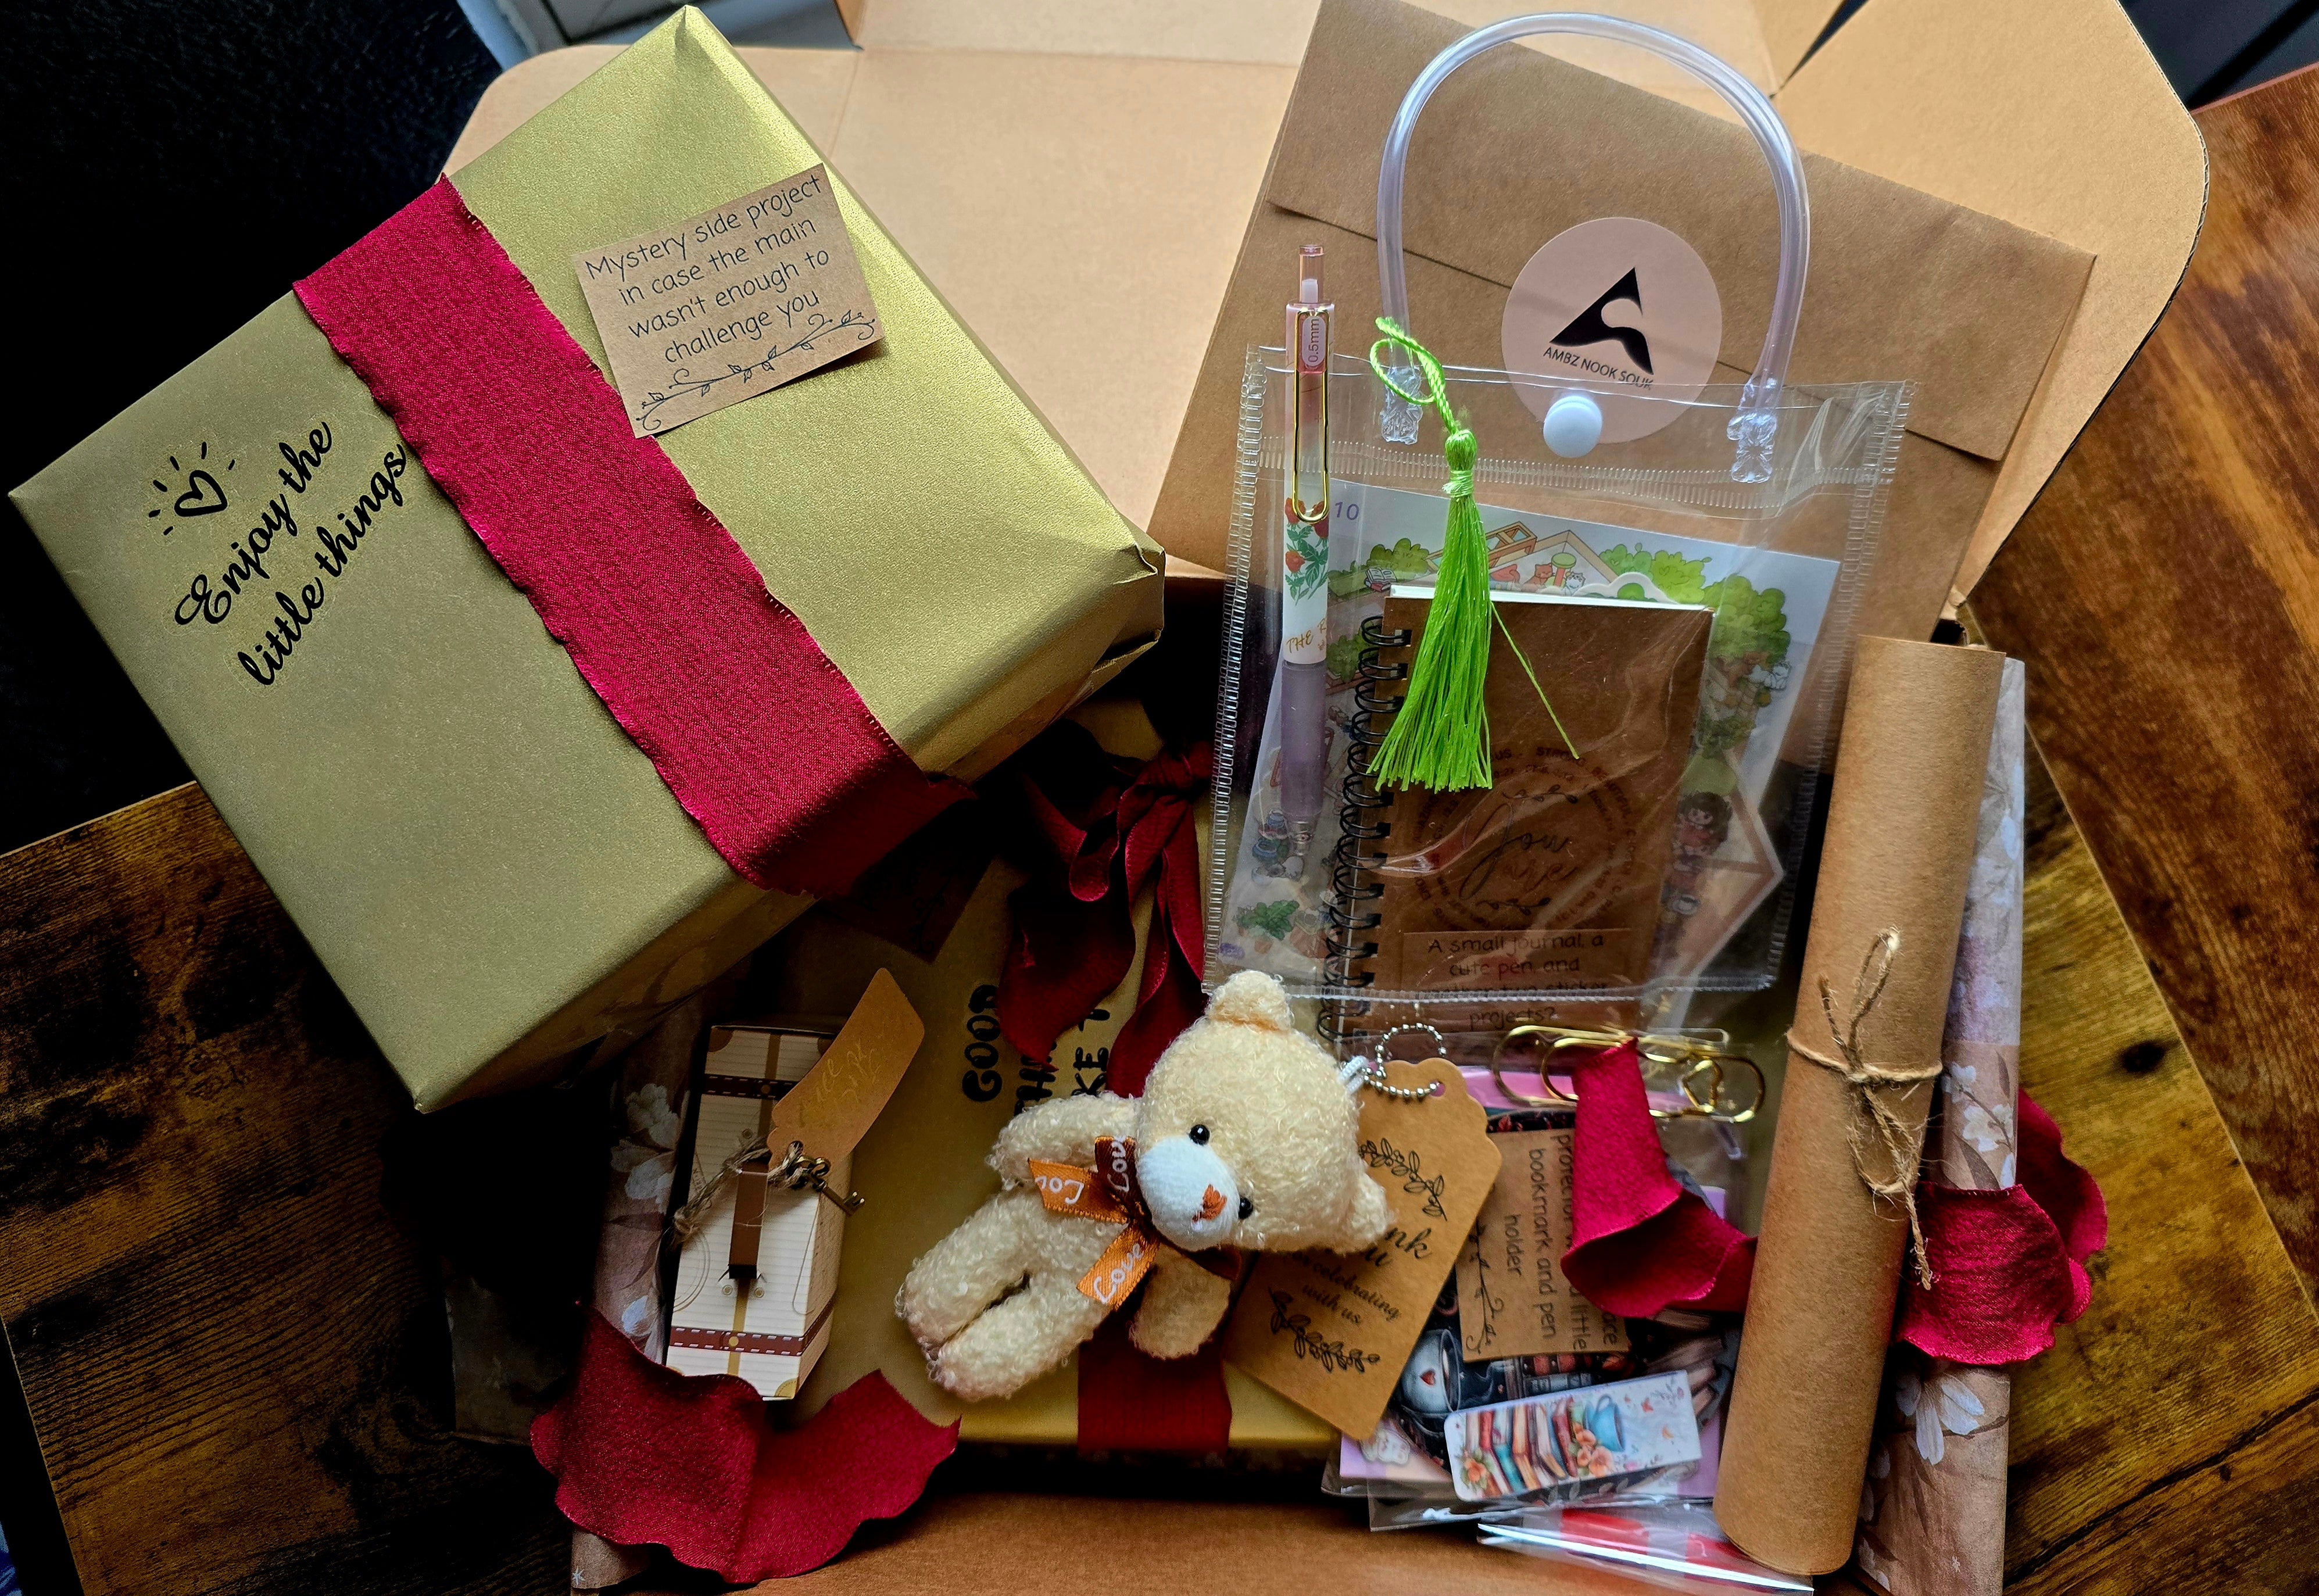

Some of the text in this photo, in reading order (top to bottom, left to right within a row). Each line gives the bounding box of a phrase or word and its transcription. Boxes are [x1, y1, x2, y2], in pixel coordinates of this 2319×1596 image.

[585, 174, 822, 282] Mystery side project
[620, 219, 817, 306] in case the main
[628, 250, 829, 339] wasn't enough to
[664, 291, 819, 363] challenge you
[1308, 318, 1320, 363] 0.5mm
[1543, 347, 1654, 390] AMBZ NOOK SOUK
[174, 421, 332, 625] Enjoy the
[1335, 502, 1359, 520] 10
[238, 443, 407, 685] little things
[1287, 630, 1314, 653] THE
[1428, 939, 1443, 953] A
[1450, 936, 1505, 953] small
[1592, 935, 1604, 947] a
[1543, 958, 1580, 972] and
[1504, 1214, 1525, 1277] holder
[1529, 1148, 1557, 1339] bookmark and pen
